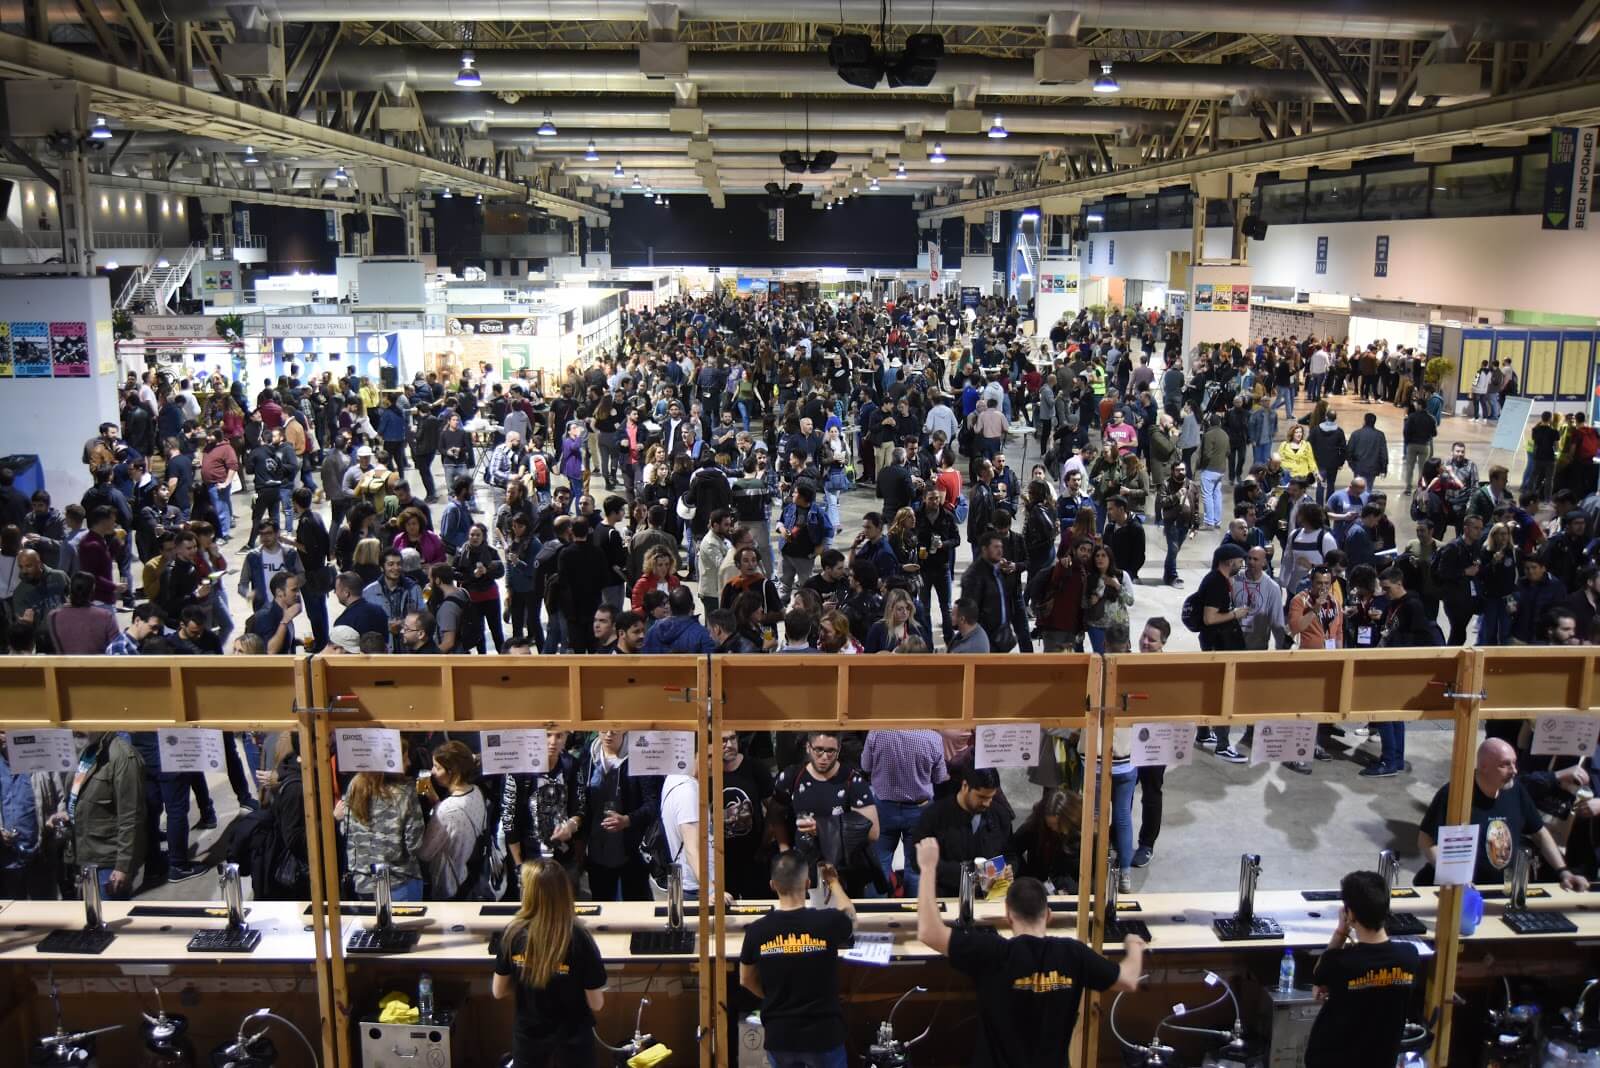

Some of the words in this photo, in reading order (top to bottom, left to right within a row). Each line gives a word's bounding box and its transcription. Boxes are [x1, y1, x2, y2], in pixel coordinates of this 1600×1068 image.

[1578, 133, 1593, 193] INFORMER
[1575, 198, 1587, 229] BEER
[263, 563, 286, 571] FILA
